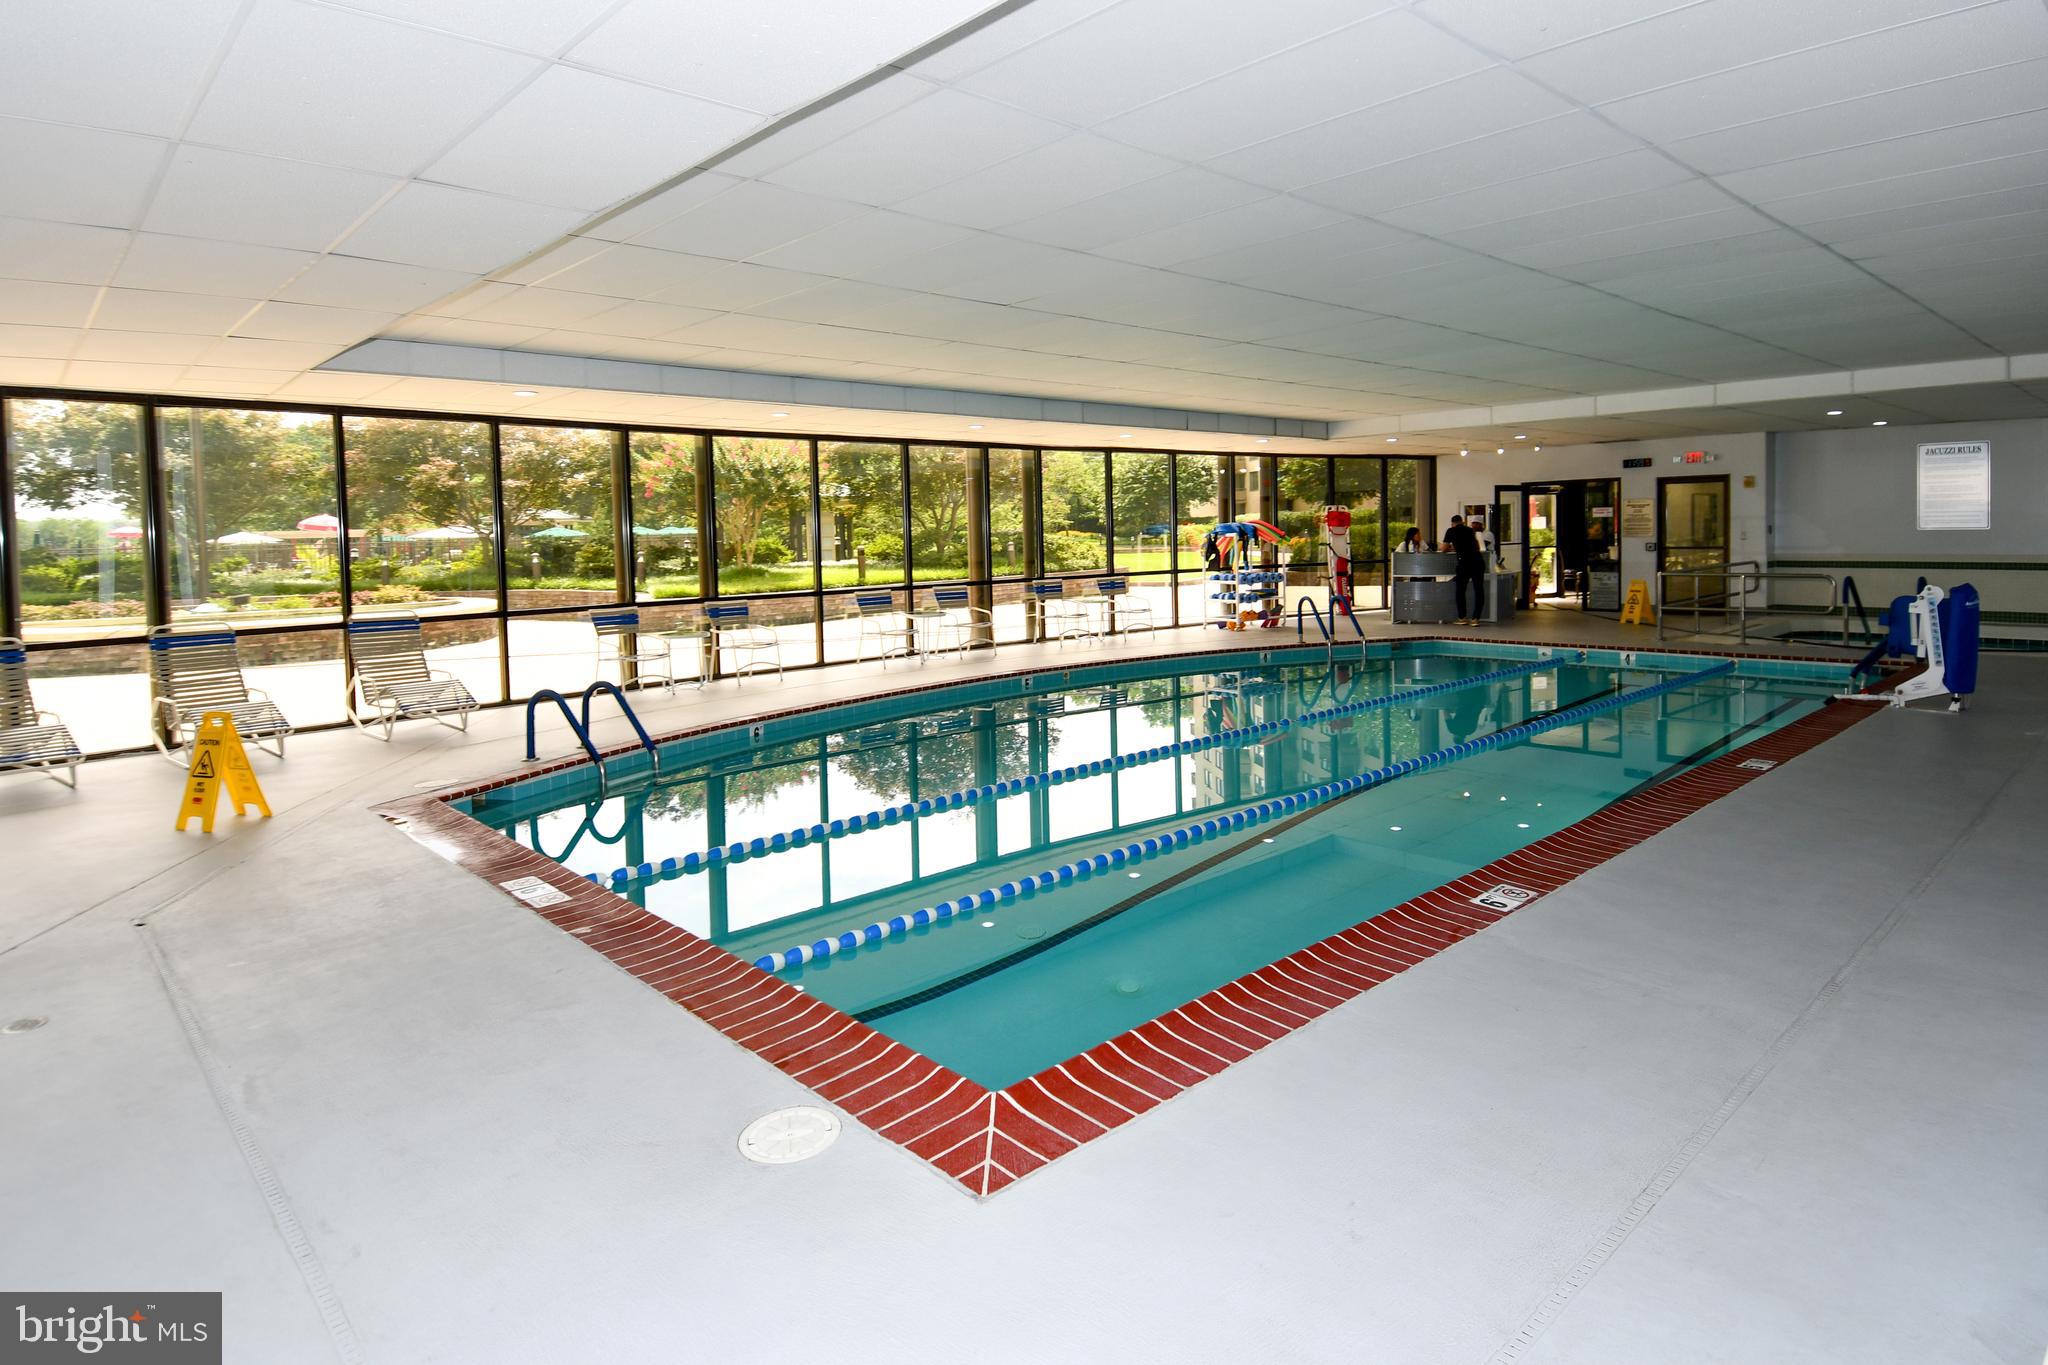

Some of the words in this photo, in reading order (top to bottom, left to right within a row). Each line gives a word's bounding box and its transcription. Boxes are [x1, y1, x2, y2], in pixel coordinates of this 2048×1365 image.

[1925, 447, 1956, 456] JACUZZI
[1957, 445, 1982, 454] RULES
[753, 726, 760, 737] 6
[1479, 898, 1508, 909] 6
